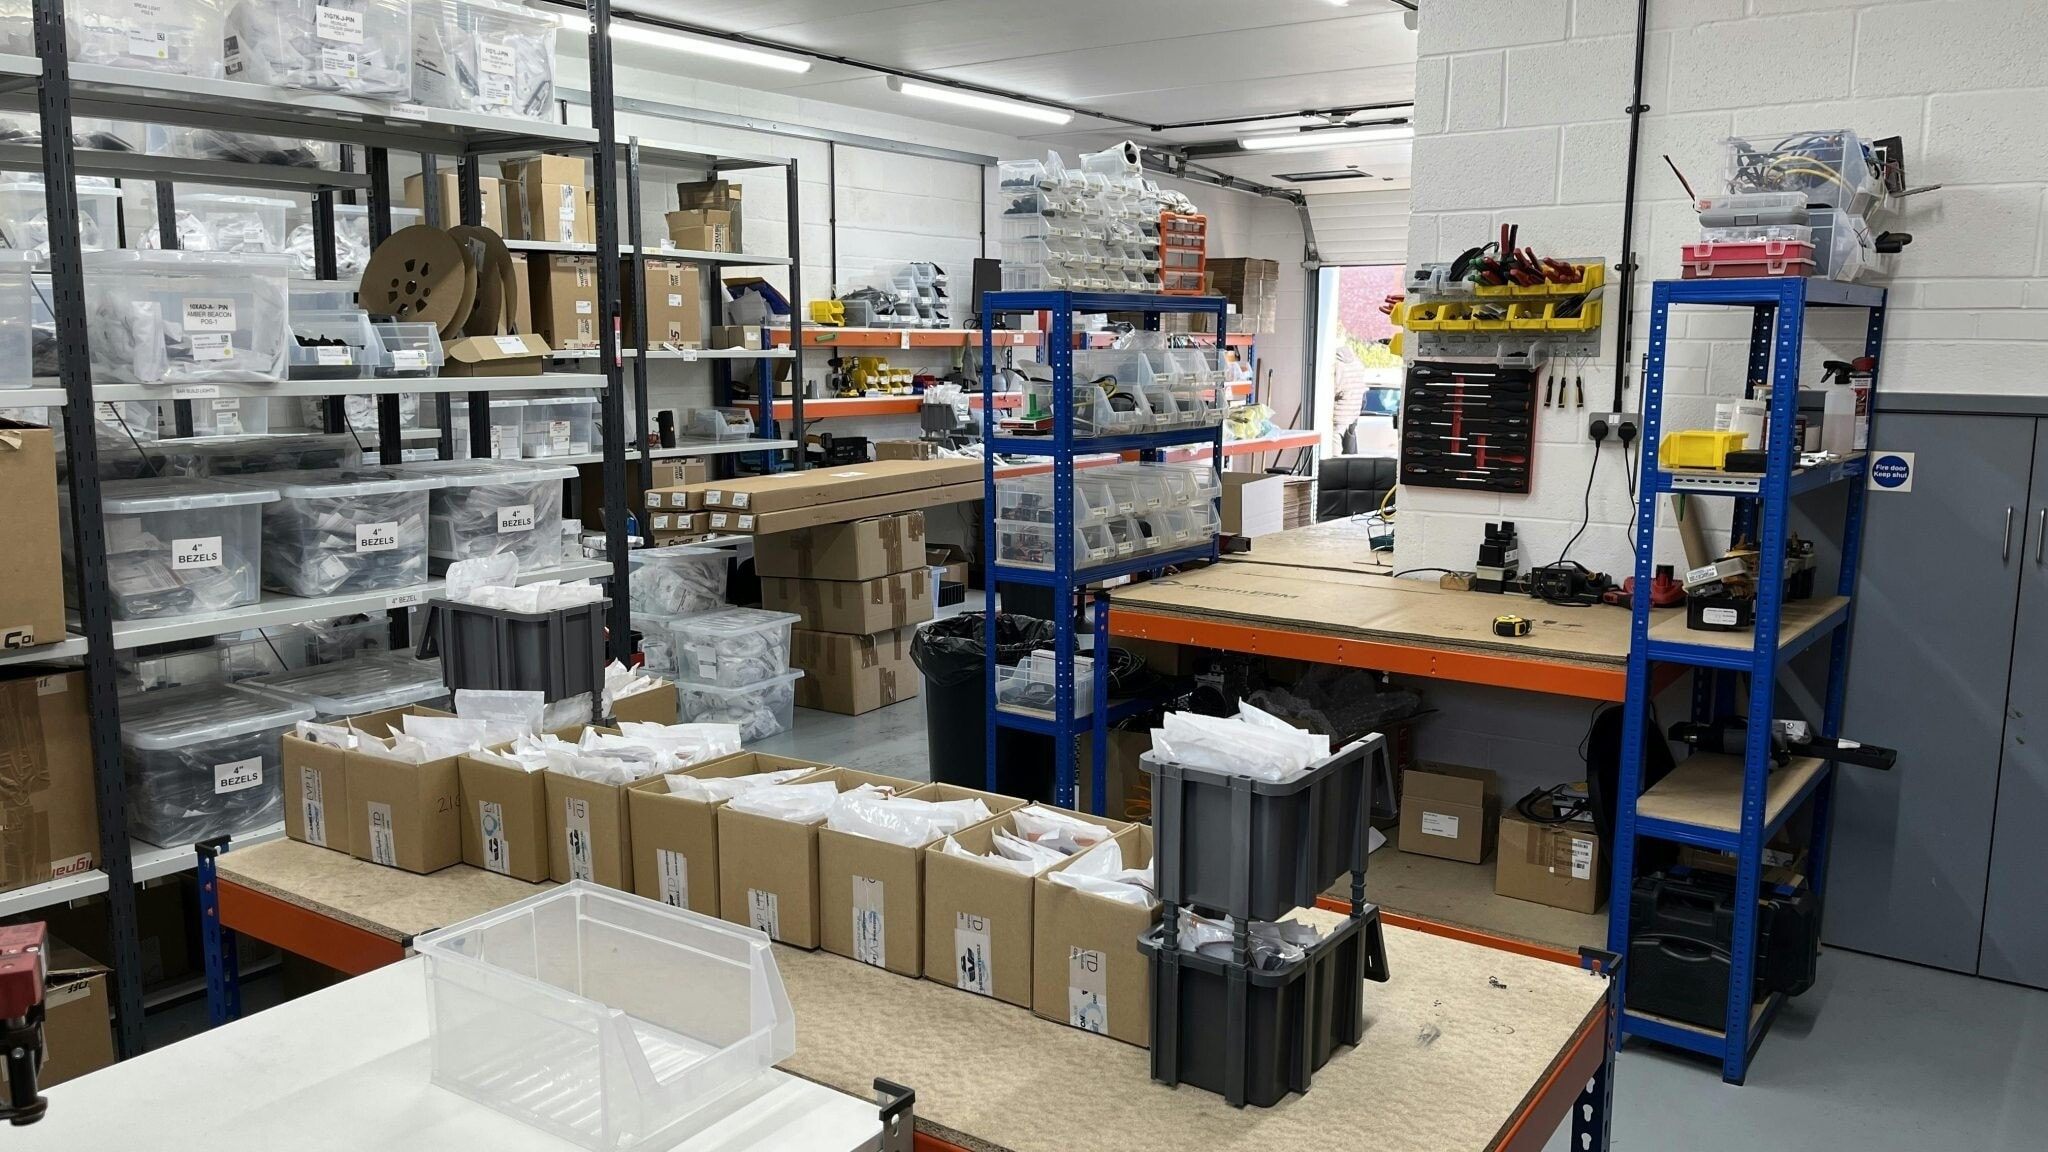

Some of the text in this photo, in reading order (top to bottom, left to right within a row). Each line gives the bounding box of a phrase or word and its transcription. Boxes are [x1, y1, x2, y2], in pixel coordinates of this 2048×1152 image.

[1873, 471, 1908, 479] Keep shut
[512, 510, 521, 518] 4"
[502, 517, 532, 528] BEZELS
[372, 528, 382, 536] 4"
[361, 536, 394, 547] BEZELS
[191, 543, 203, 552] 4"
[178, 552, 218, 564] BEZELS
[398, 594, 417, 604] BEZEL
[233, 765, 244, 774] 4"
[220, 772, 258, 787] BEZELS
